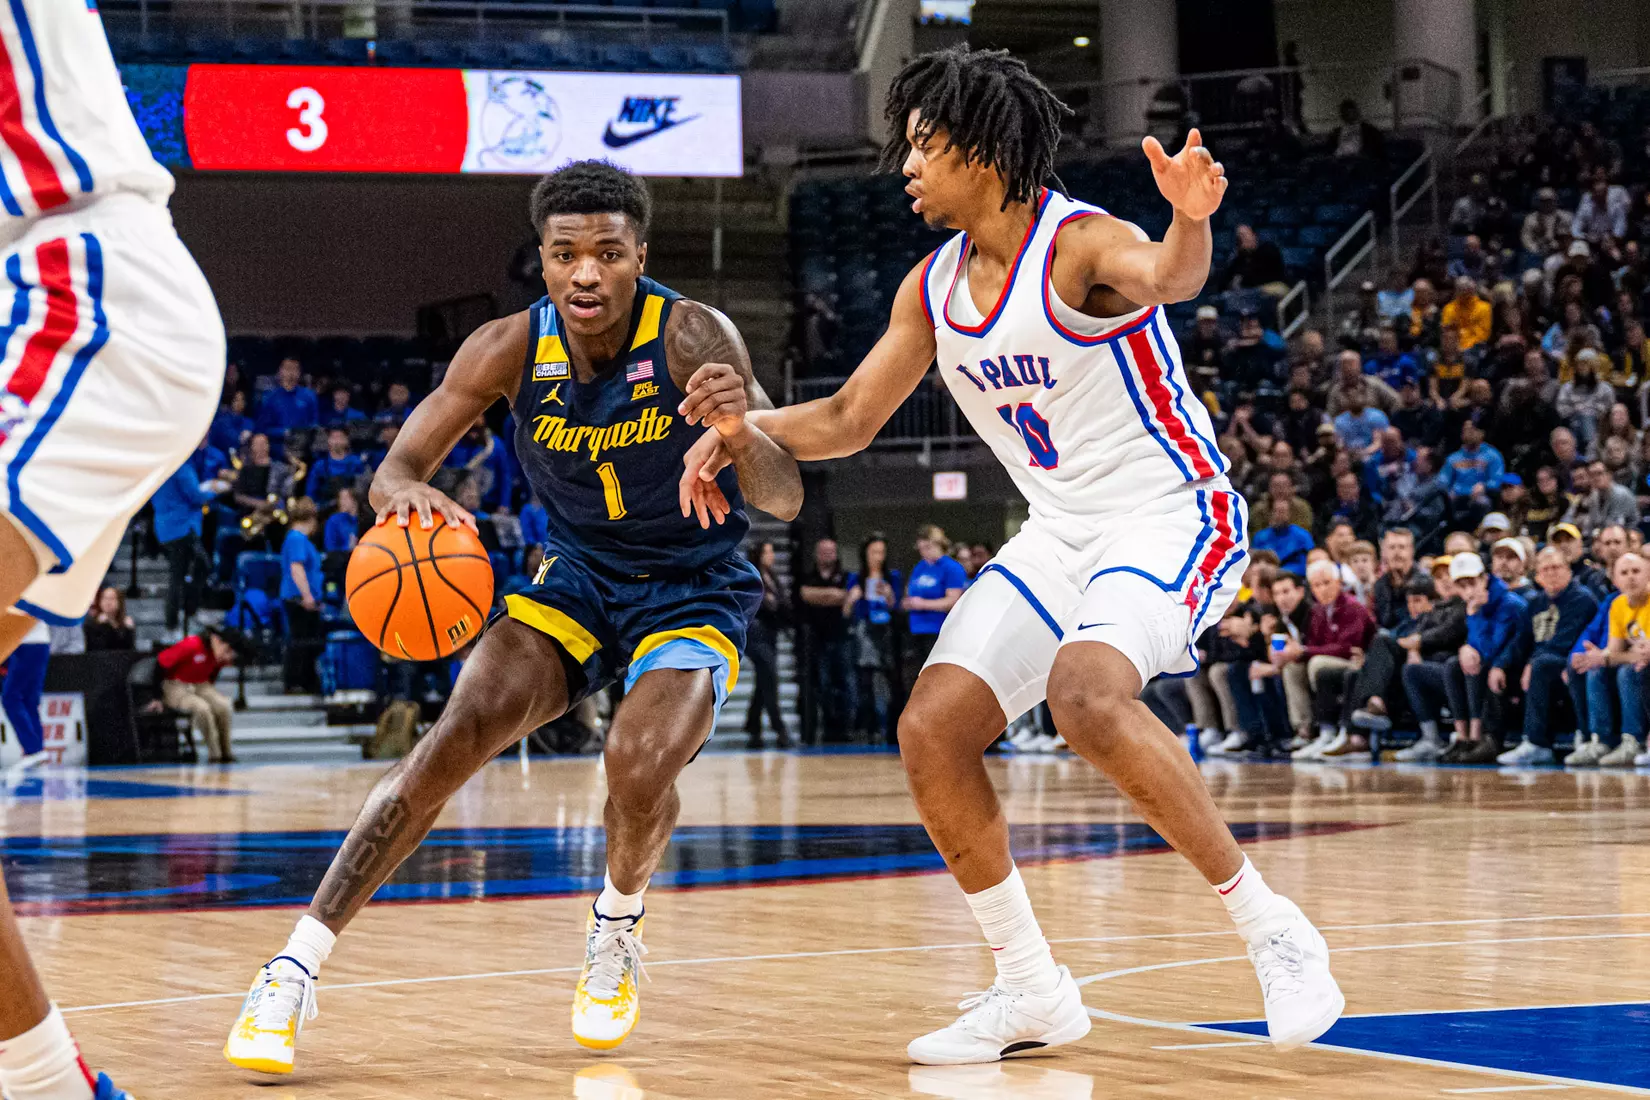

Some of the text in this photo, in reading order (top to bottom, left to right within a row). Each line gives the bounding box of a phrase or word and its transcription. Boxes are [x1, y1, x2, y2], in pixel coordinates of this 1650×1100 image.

[286, 86, 328, 152] 3
[618, 96, 681, 126] NIKE
[632, 386, 660, 398] EAST
[635, 381, 653, 390] BIG
[532, 407, 673, 462] Marquette
[996, 403, 1059, 471] 10
[596, 462, 627, 520] 1
